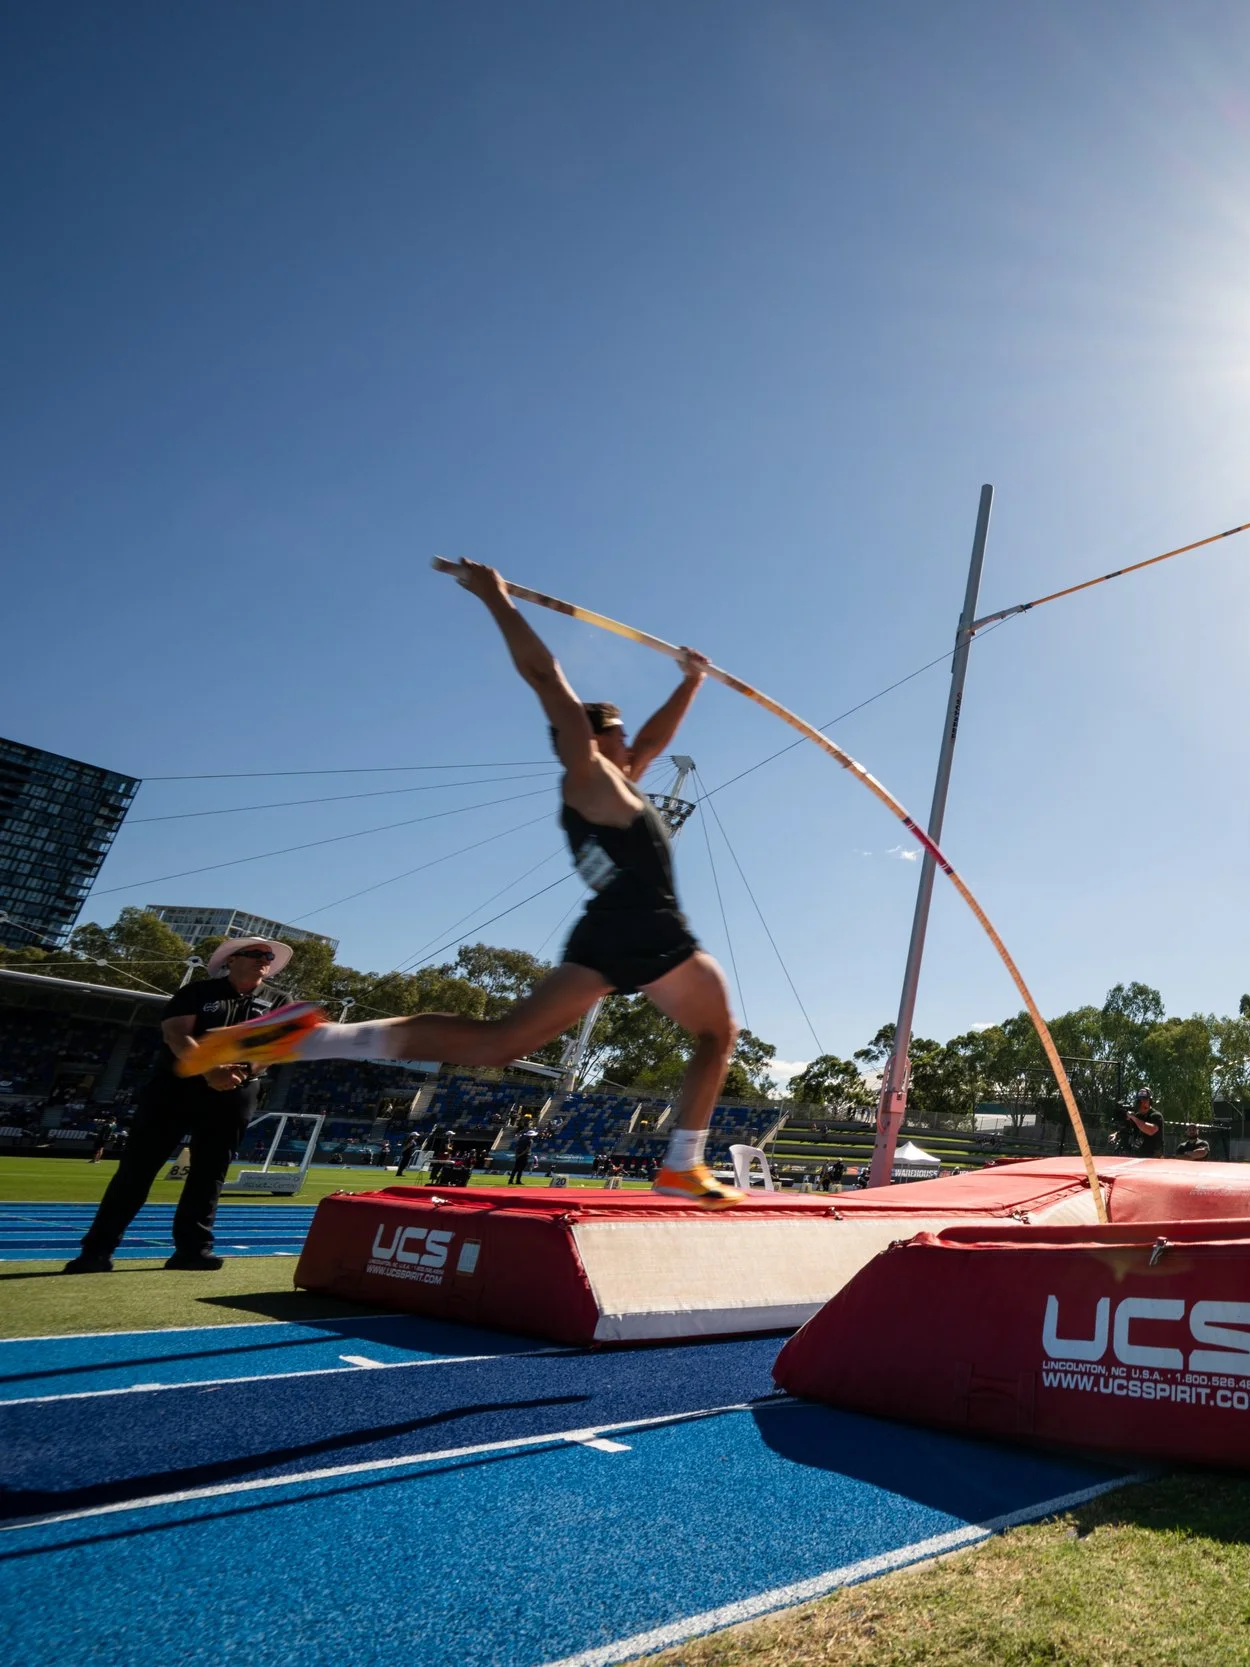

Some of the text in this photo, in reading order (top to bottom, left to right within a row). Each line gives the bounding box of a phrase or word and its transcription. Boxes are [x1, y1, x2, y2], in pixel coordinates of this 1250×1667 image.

[555, 1177, 567, 1186] 20
[371, 1223, 453, 1268] UCS
[1042, 1361, 1109, 1376] LINCOLNTON,
[1111, 1366, 1127, 1377] NC
[1131, 1368, 1164, 1381] U.S.A.
